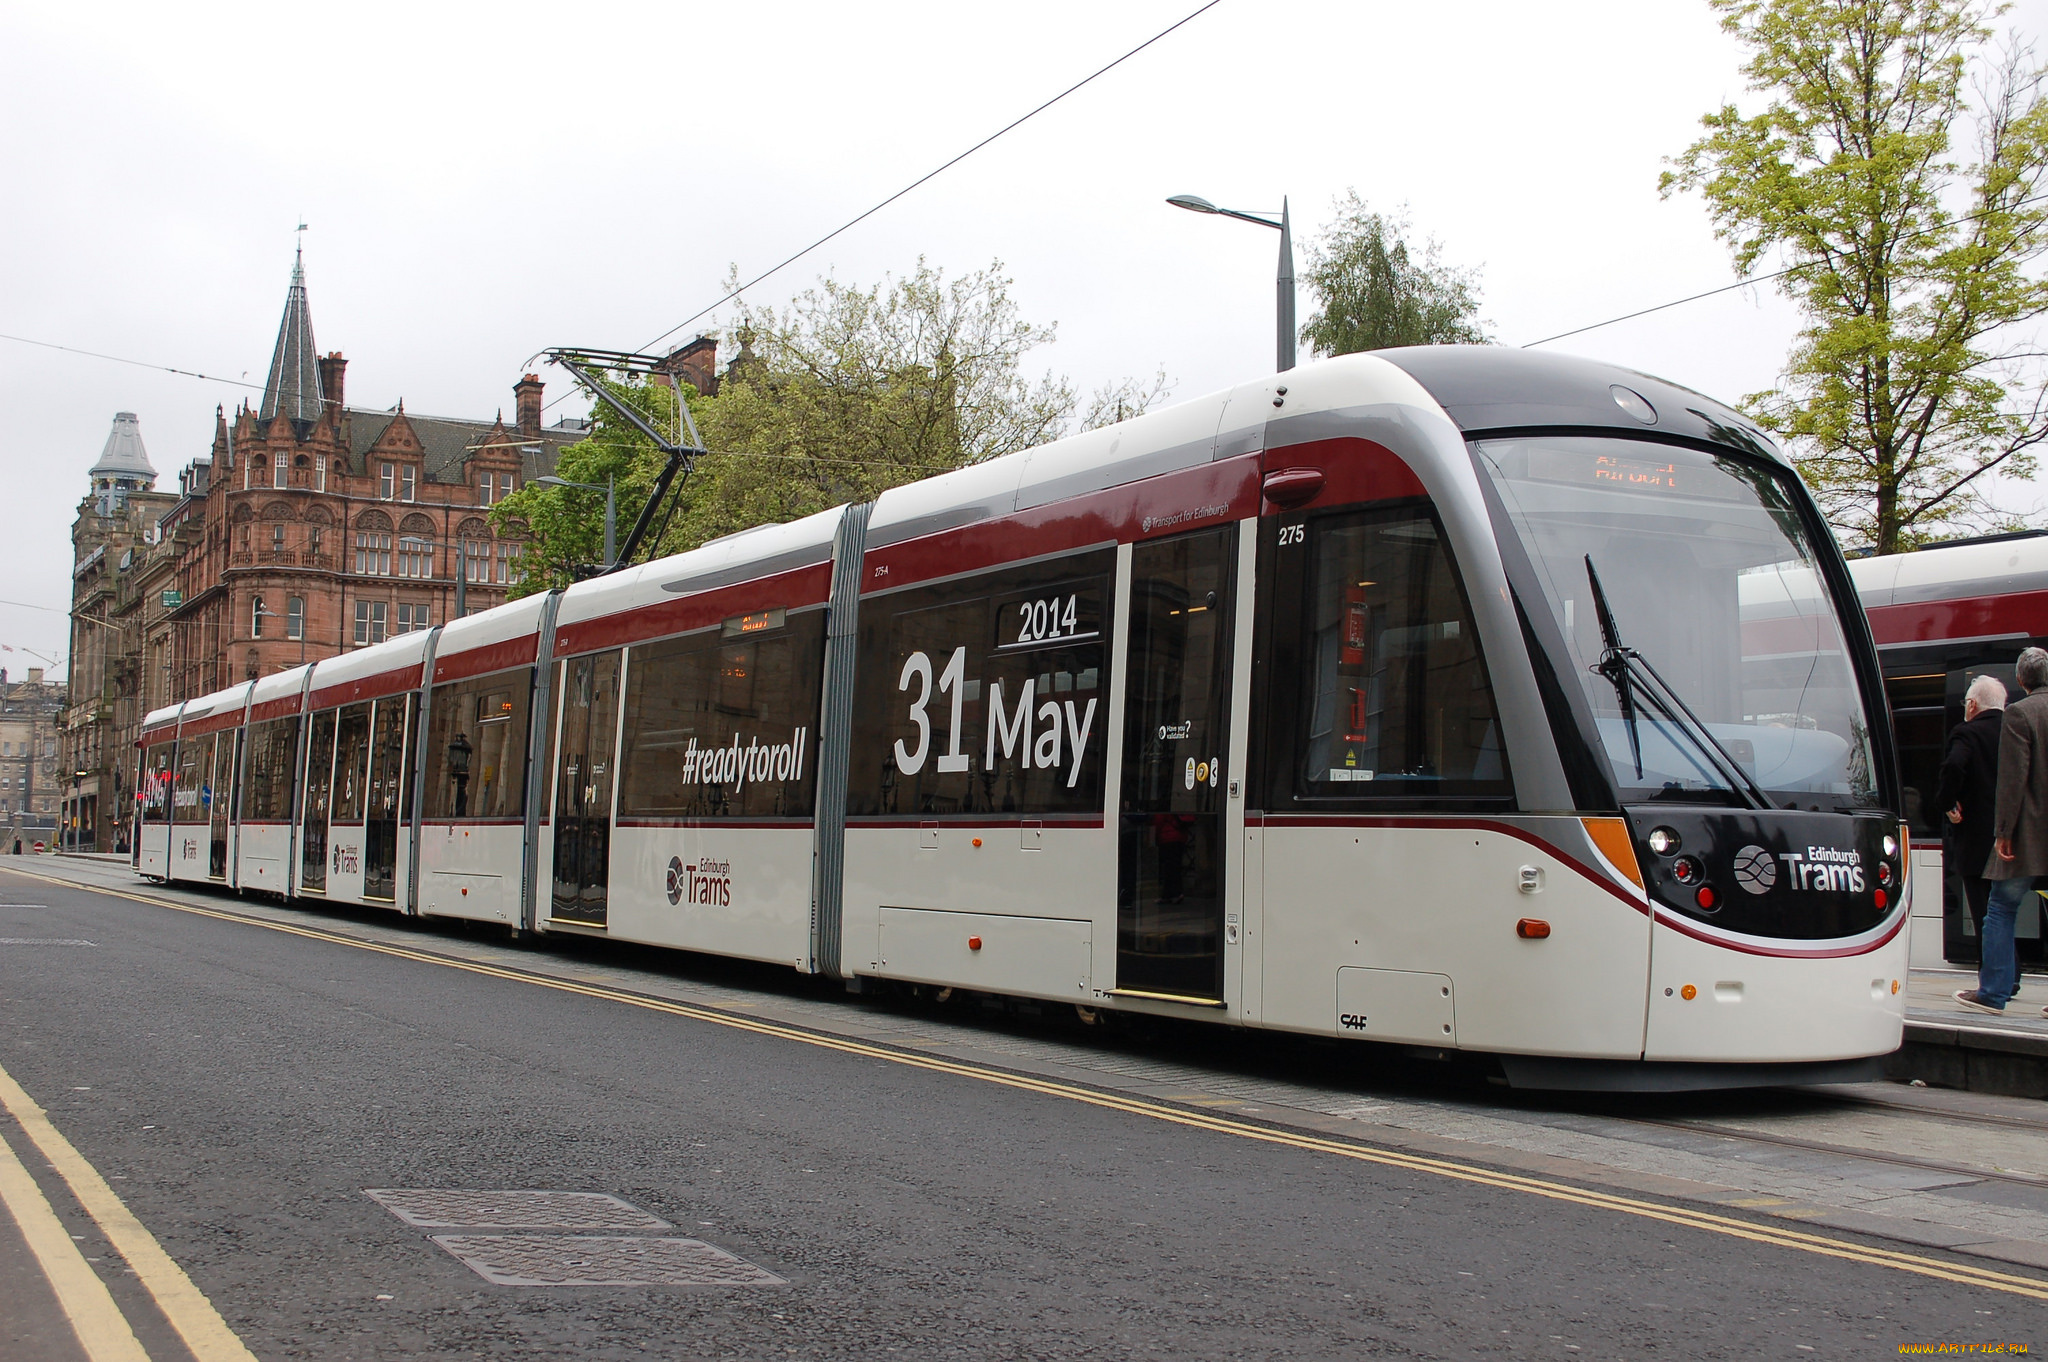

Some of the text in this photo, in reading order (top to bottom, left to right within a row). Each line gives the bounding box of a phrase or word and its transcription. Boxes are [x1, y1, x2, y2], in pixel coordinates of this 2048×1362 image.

[1152, 501, 1229, 528] Transport for Edinburgh
[1278, 523, 1305, 546] 275
[1018, 594, 1077, 642] 2014
[894, 646, 1098, 788] 31 May
[682, 726, 807, 794] #readytoroll
[700, 857, 730, 877] Edinburgh
[1807, 845, 1861, 866] Edinburgh
[686, 864, 731, 907] Trams
[1779, 853, 1865, 893] Trams
[1340, 1013, 1367, 1030] CAF
